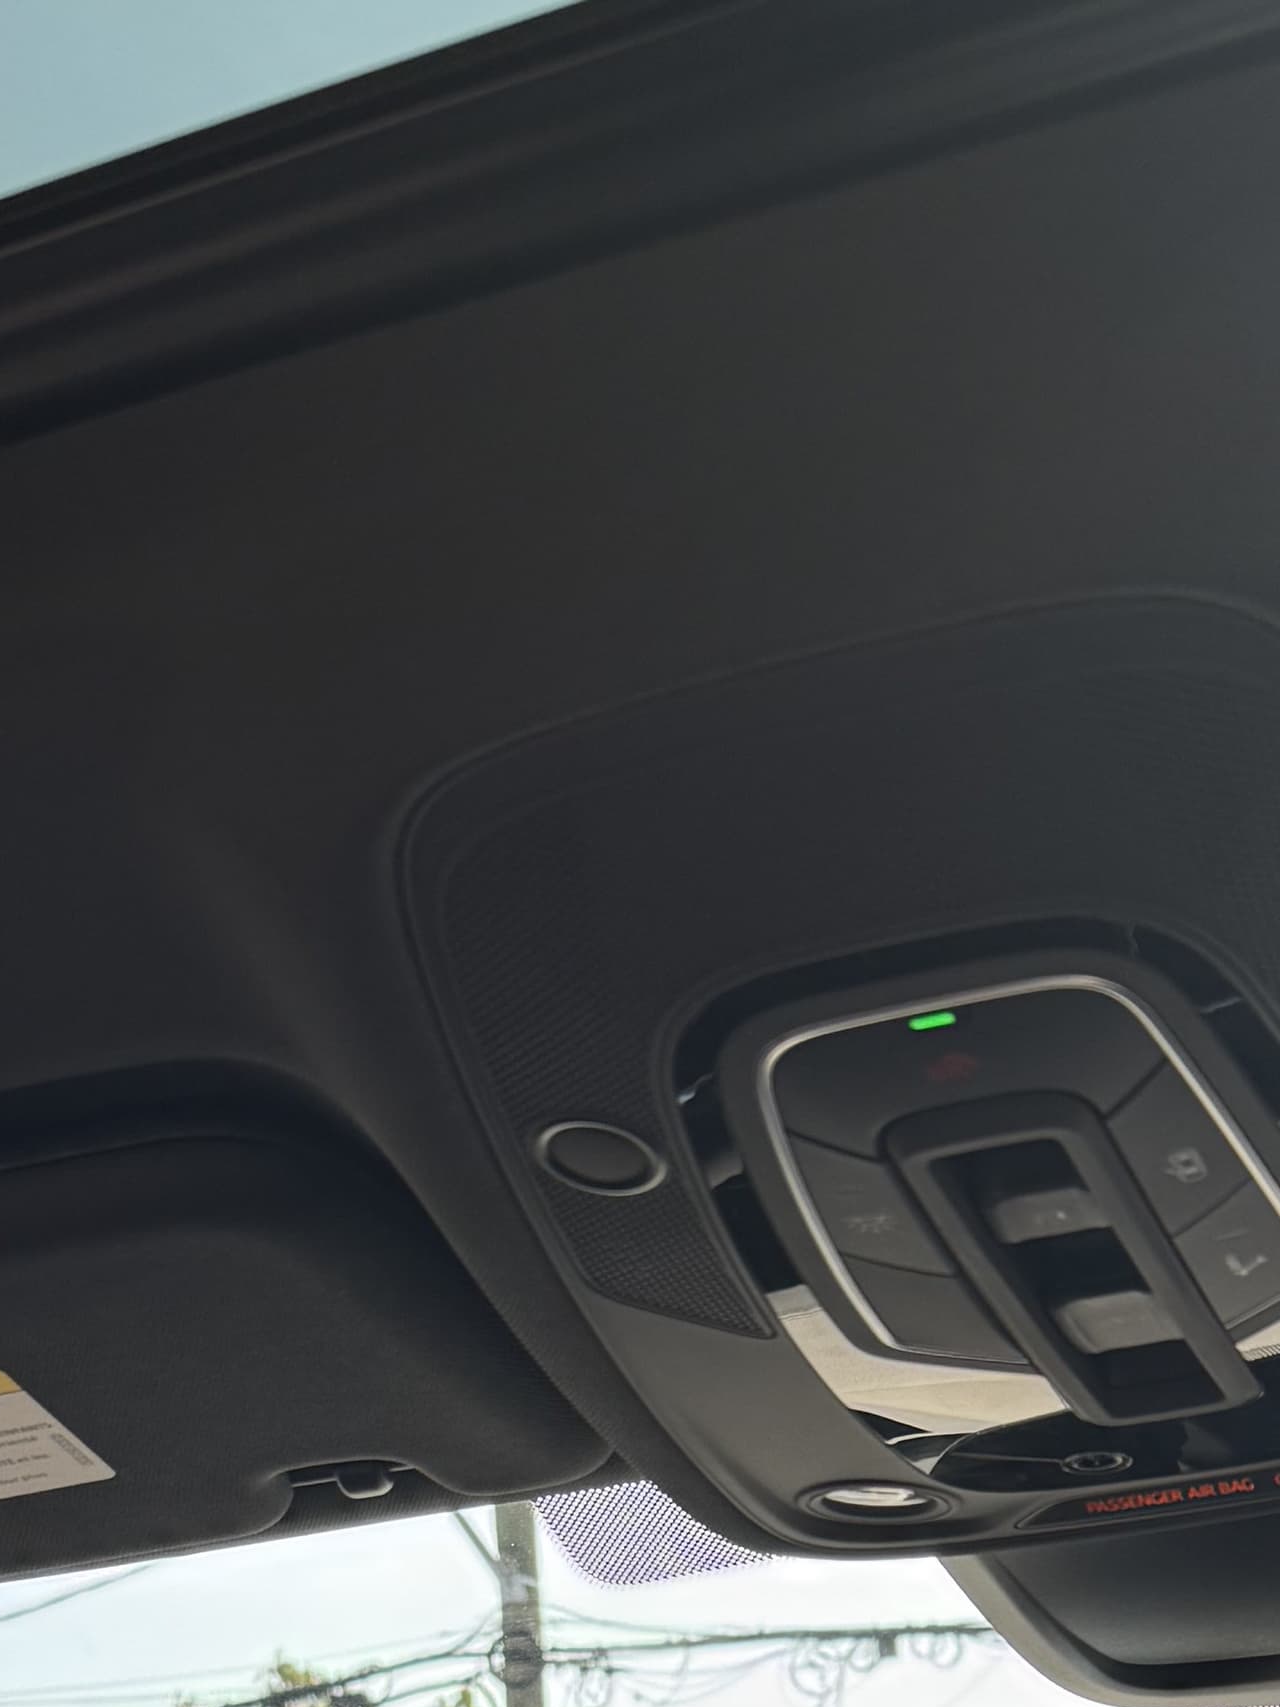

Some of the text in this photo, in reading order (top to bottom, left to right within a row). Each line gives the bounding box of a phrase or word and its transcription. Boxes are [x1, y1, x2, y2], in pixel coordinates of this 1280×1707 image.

[1085, 1490, 1182, 1513] PASSENGER
[1188, 1484, 1216, 1500] AIR
[1218, 1478, 1255, 1496] BAG
